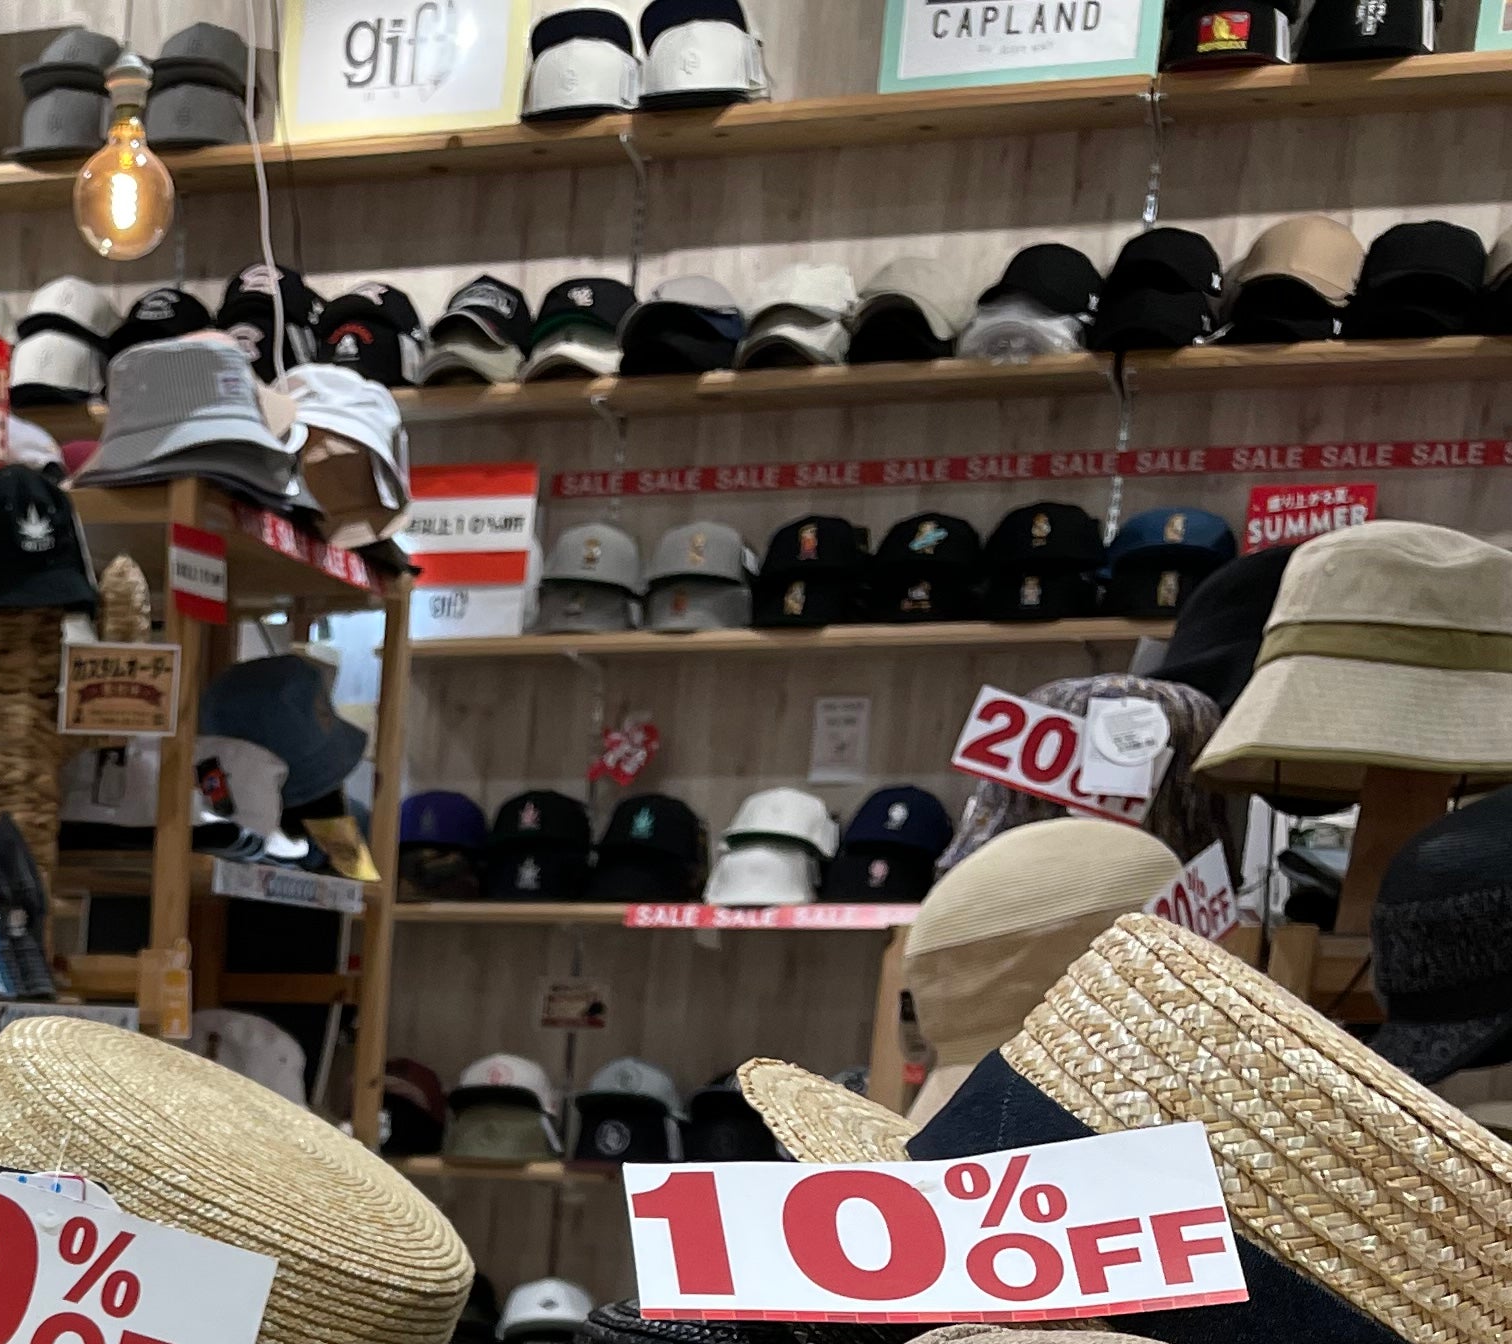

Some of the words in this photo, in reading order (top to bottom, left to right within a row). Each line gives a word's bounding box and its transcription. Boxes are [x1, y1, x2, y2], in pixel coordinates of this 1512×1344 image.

[932, 1, 1101, 39] CAPLAND
[343, 0, 456, 88] gif
[562, 472, 624, 496] SALE
[637, 469, 701, 492] SALE
[715, 467, 779, 490] SALE
[793, 464, 859, 487] SALE
[884, 458, 951, 482] SALE
[966, 455, 1033, 479] SALE
[1050, 453, 1119, 478] SALE
[1136, 449, 1206, 474] SALE
[1232, 446, 1303, 472] SALE
[1320, 444, 1393, 468] SALE
[1412, 442, 1485, 466] SALE
[1247, 504, 1368, 543] SUMMER
[637, 906, 699, 925] SALE
[713, 906, 776, 926] SALE
[966, 1206, 1227, 1301] OFF
